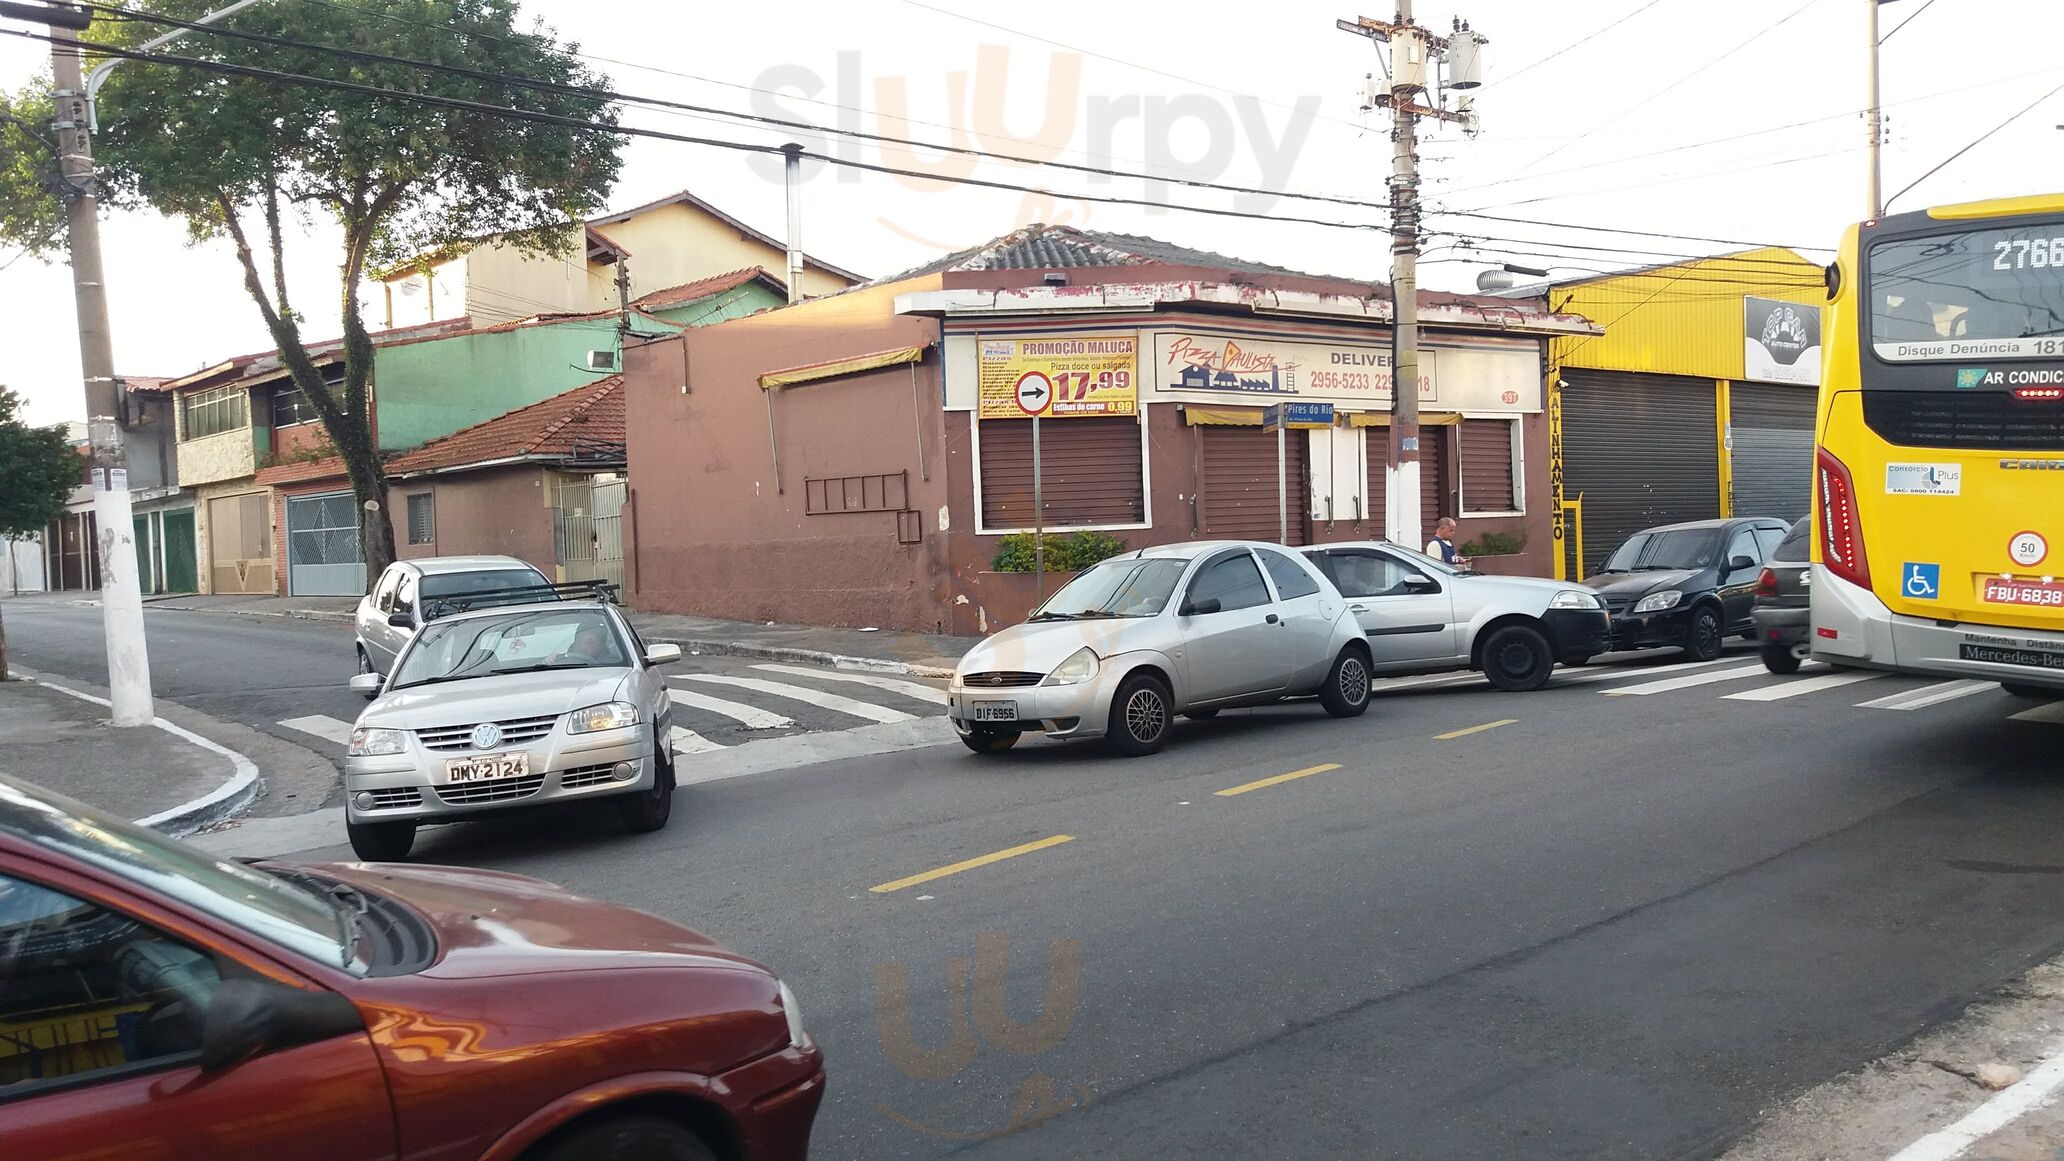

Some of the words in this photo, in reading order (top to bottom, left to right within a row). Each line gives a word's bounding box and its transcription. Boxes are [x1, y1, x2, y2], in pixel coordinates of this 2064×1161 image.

[1022, 340, 1085, 357] PROMOÇÃO
[1087, 341, 1133, 354] MALUCA
[1898, 345, 1945, 357] Disque
[1950, 342, 2020, 354] Denúncia
[1051, 362, 1070, 371] Pizza
[1072, 362, 1090, 371] doce
[1310, 371, 1370, 390] 2956-5233
[1983, 371, 2004, 385] AR
[1052, 371, 1131, 401] 17,99
[1502, 392, 1518, 404] 397
[1107, 402, 1133, 413] 0,99
[1288, 403, 1307, 414] Pires
[1309, 404, 1319, 414] do
[1321, 405, 1334, 415] Rio
[1550, 398, 1563, 540] ALINHAMENTO
[1938, 470, 1959, 480] Plus
[2020, 543, 2036, 553] 50
[1965, 633, 2017, 646] Mantenha
